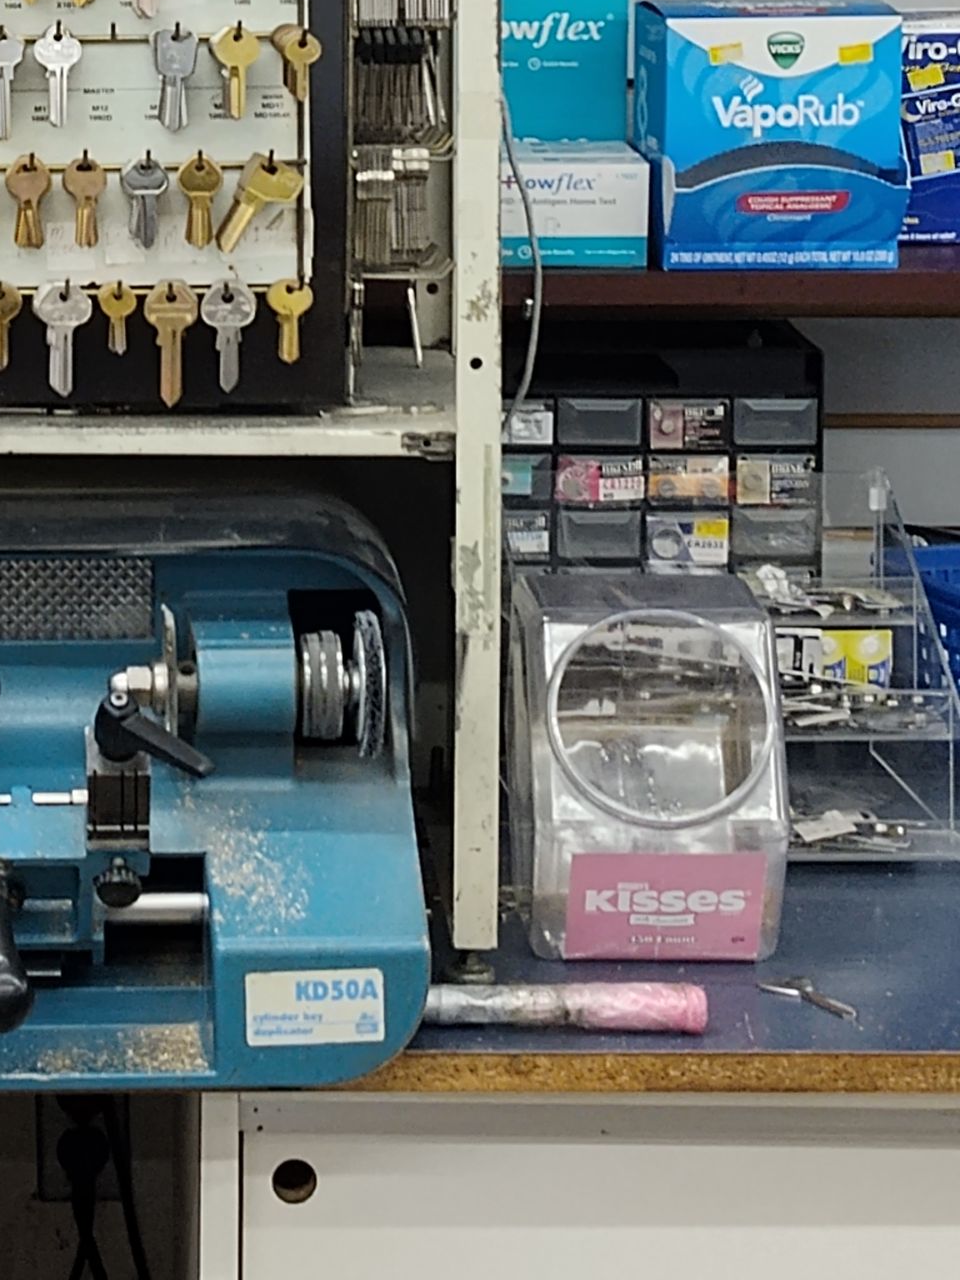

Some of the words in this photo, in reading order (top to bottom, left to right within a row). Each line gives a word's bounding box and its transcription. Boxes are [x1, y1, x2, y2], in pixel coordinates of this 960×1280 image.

[501, 11, 606, 50] owflex
[768, 43, 802, 56] VICKS
[711, 92, 861, 139] VapoRub
[525, 172, 597, 196] owflex
[532, 197, 568, 207] Antigen
[569, 197, 596, 206] Home
[599, 197, 617, 206] Test
[295, 978, 379, 1002] KD50A
[252, 1012, 300, 1023] cylinder
[303, 1010, 324, 1023] key
[253, 1026, 314, 1038] duplicator
